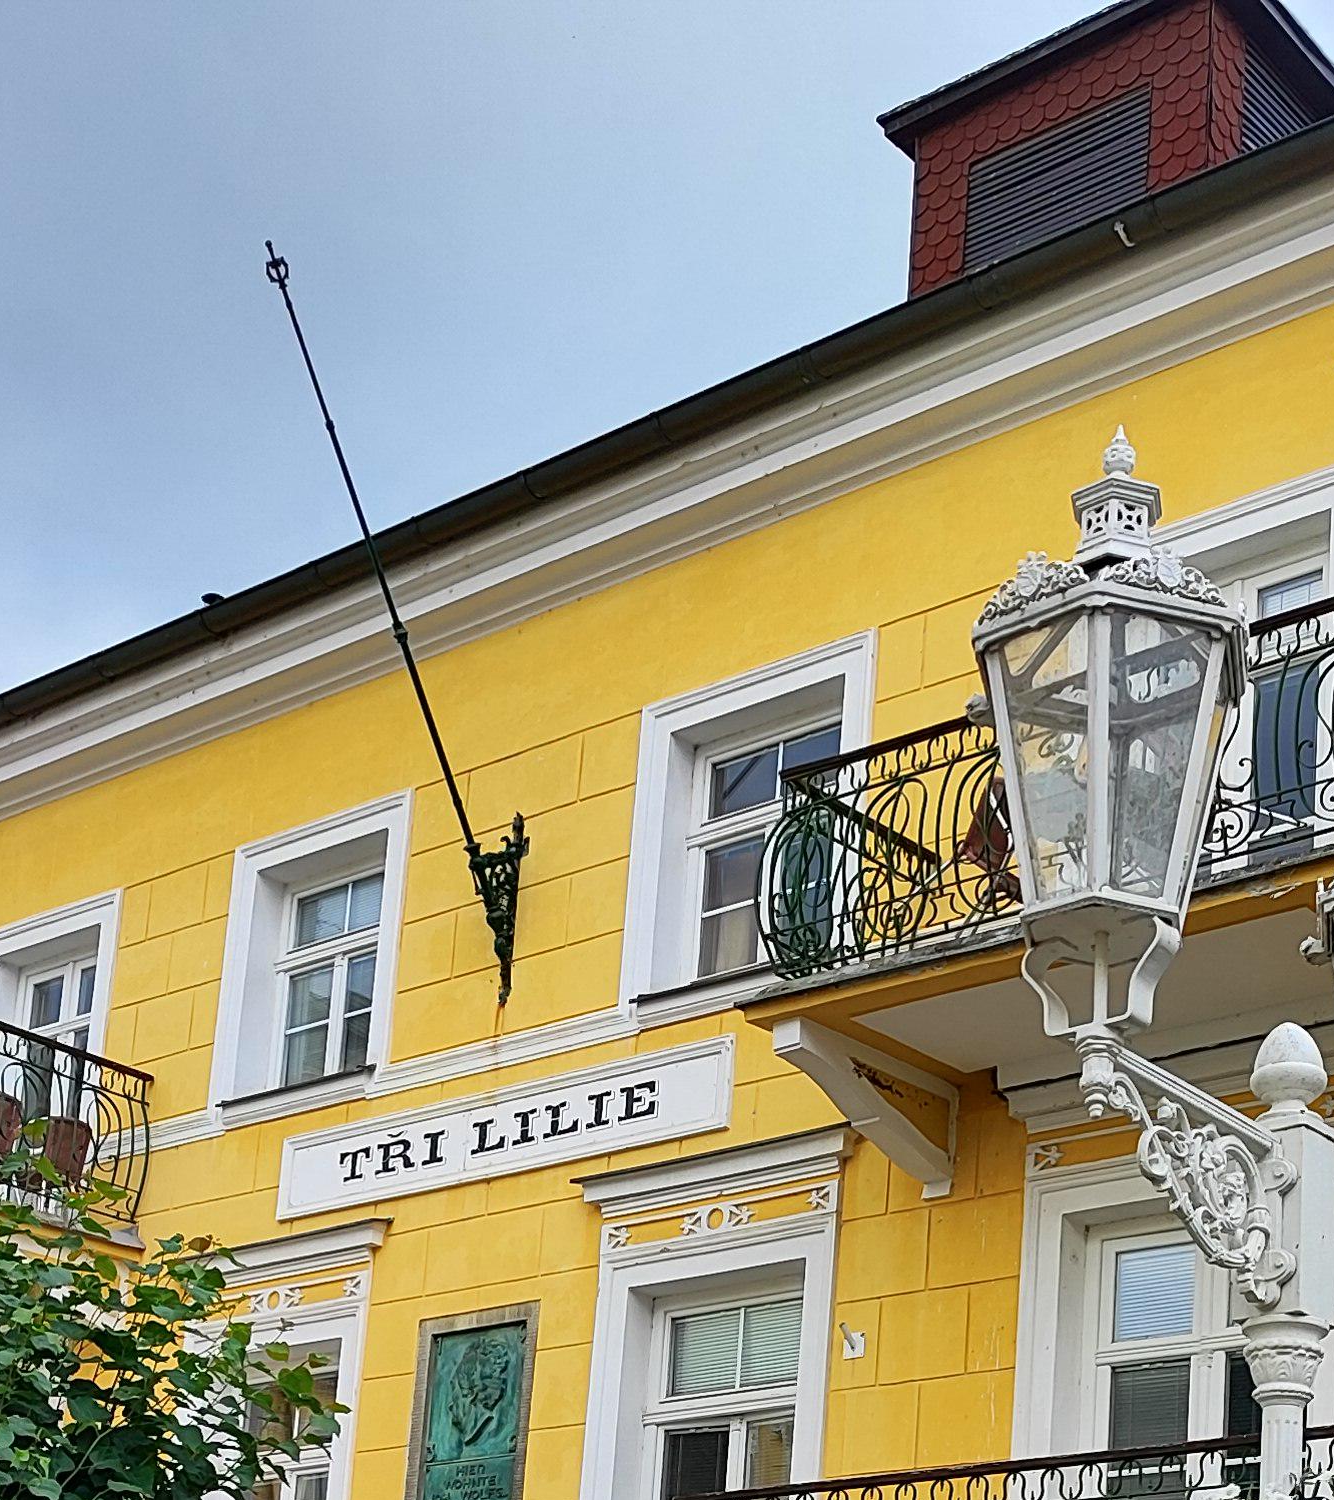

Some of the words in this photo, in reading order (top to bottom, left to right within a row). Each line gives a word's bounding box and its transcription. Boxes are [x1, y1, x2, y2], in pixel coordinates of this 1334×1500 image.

[340, 1128, 447, 1183] TŘI
[470, 1079, 658, 1157] LILIE
[444, 1474, 497, 1491] WOHNTE
